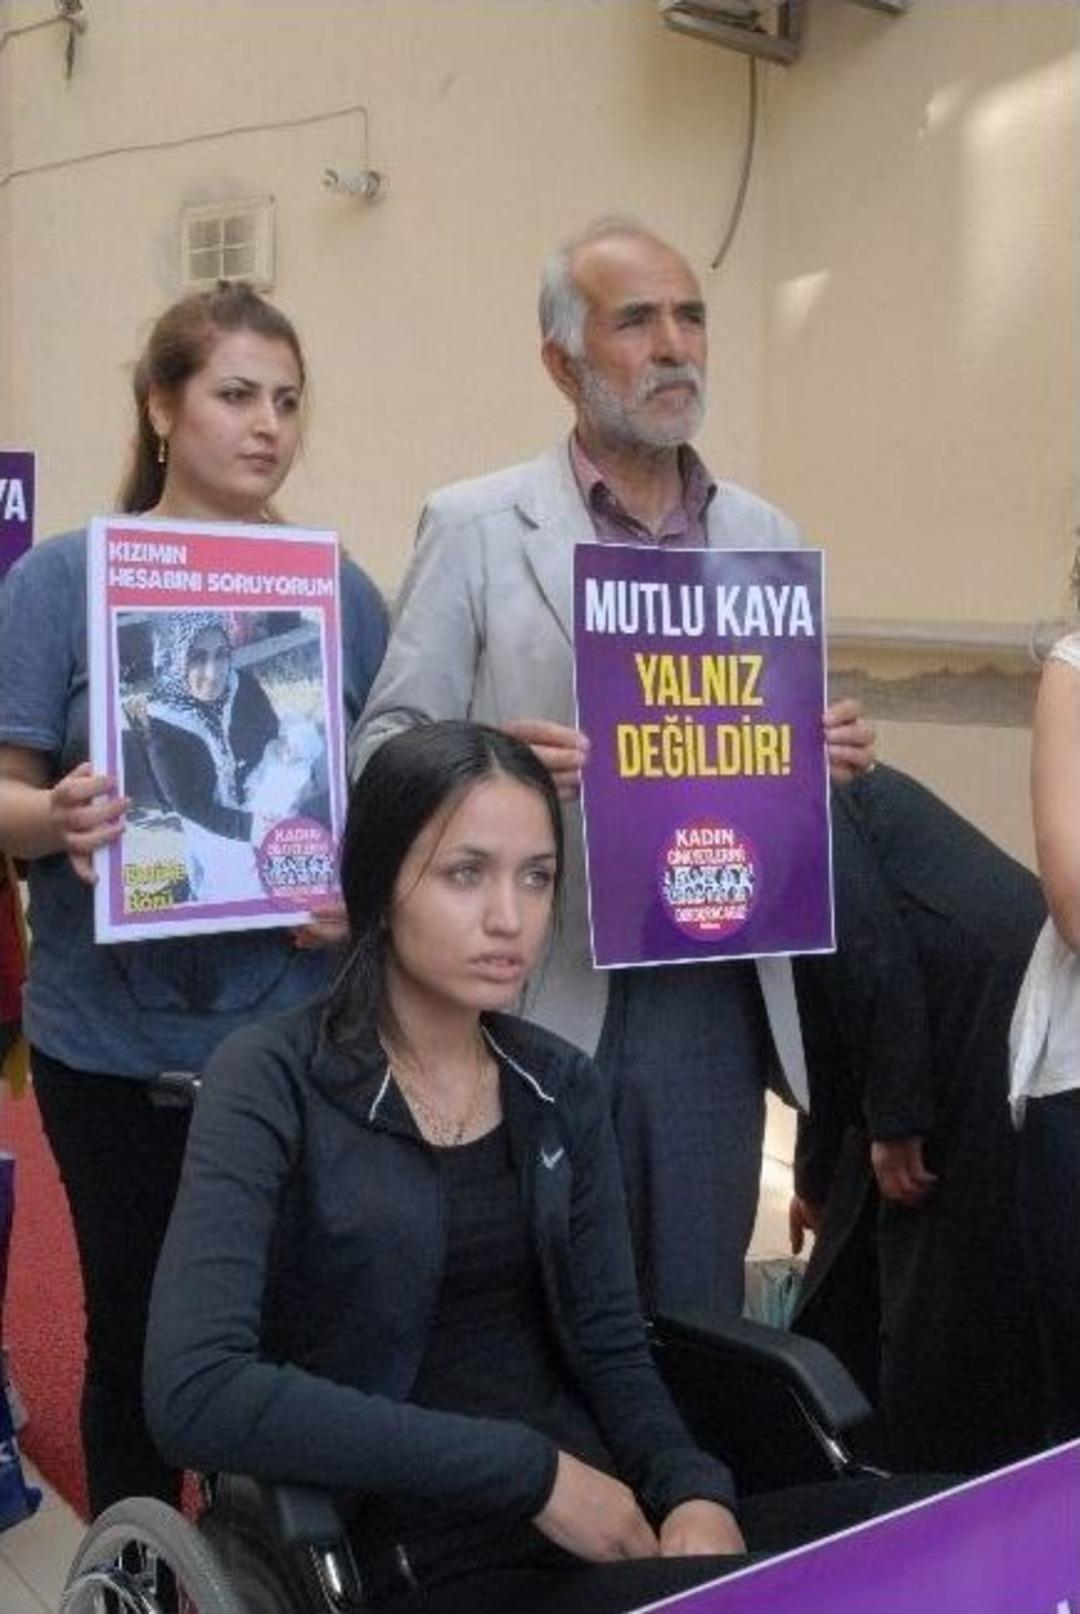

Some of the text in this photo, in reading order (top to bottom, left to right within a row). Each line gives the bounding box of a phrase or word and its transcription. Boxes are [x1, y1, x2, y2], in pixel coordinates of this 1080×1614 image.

[108, 541, 187, 564] KIZIMIN
[109, 567, 334, 597] HESABINI SORUYORUM
[585, 578, 815, 636] MUTLU KAYA
[635, 653, 763, 706] YALNIZ
[617, 714, 791, 778] DEĞİLDİR!
[675, 828, 733, 847] KADIN
